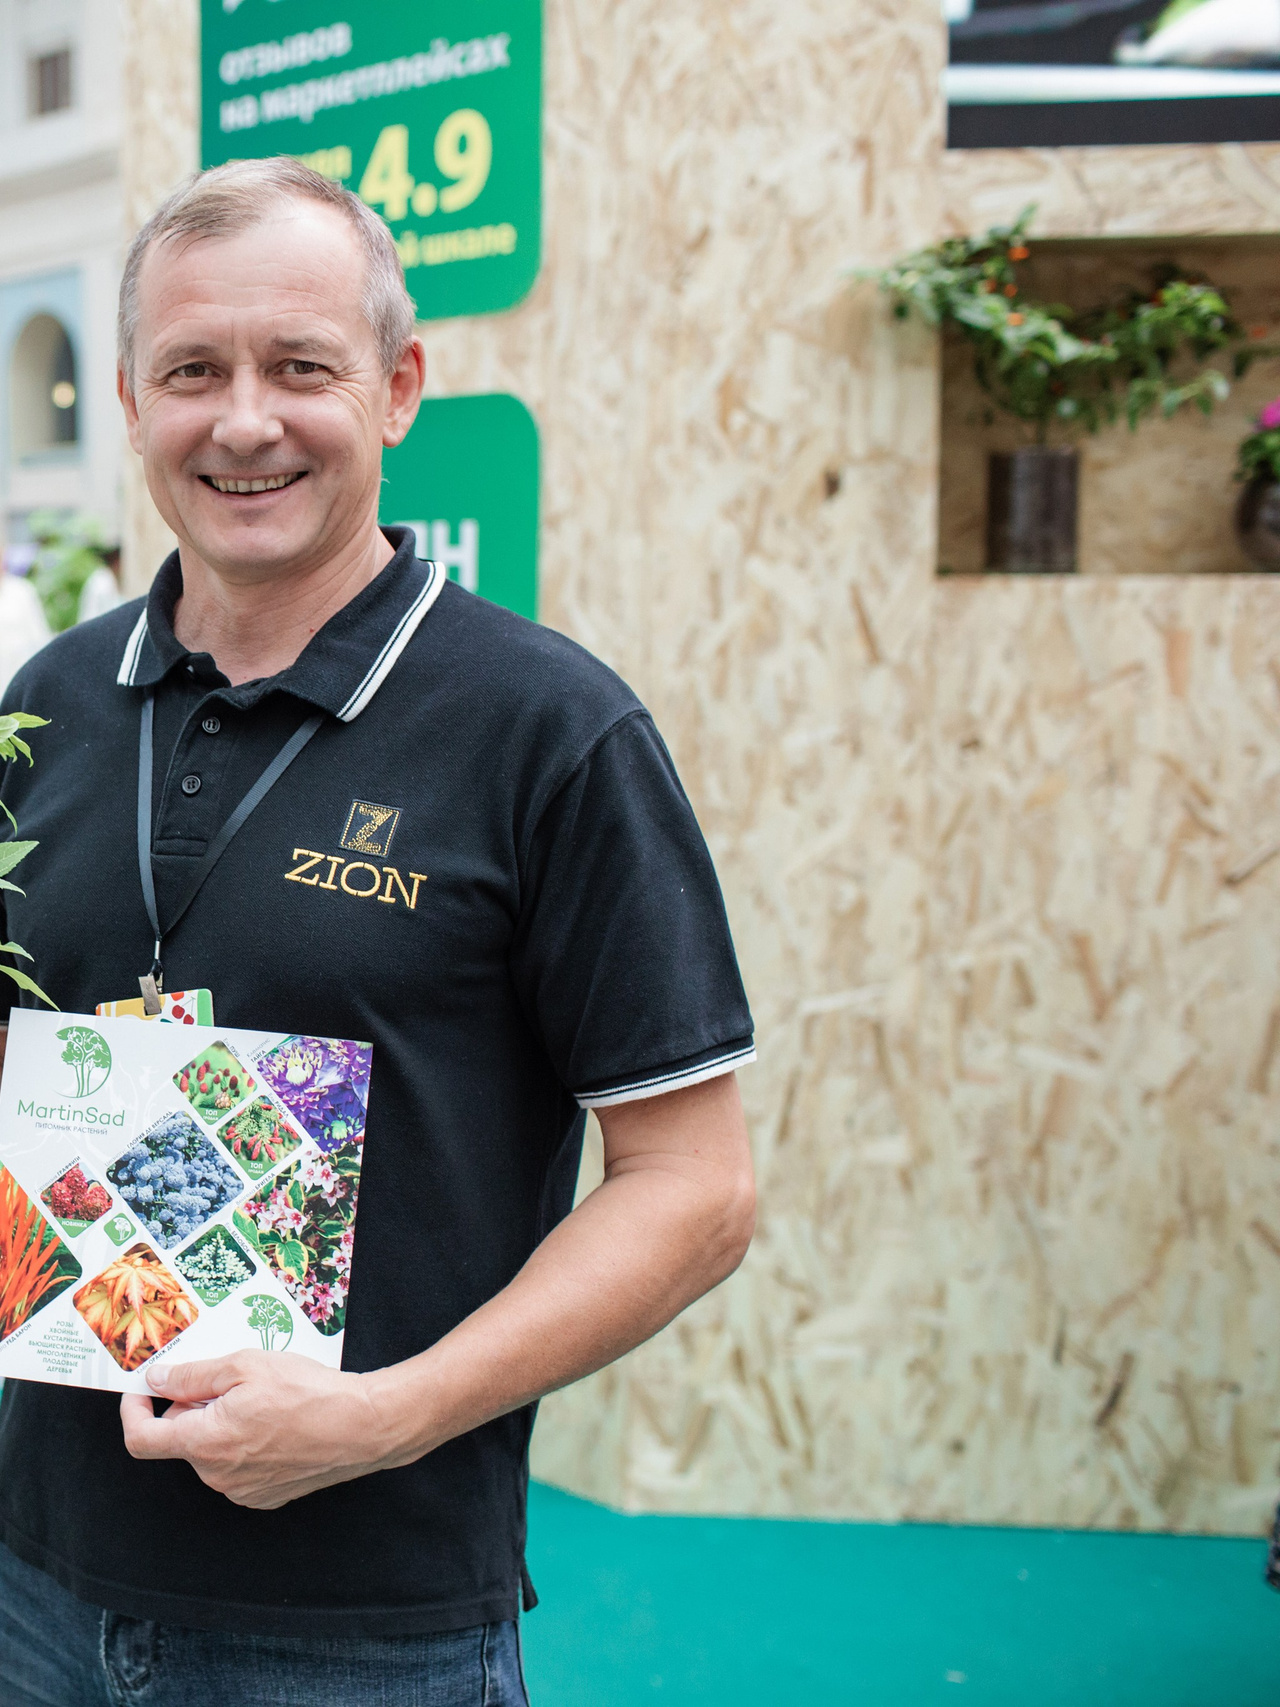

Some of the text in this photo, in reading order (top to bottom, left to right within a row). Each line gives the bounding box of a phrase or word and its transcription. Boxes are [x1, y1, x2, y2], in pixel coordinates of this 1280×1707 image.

[219, 22, 352, 84] отзывов
[219, 32, 511, 132] на маркетплейсах
[358, 108, 493, 221] 4.9
[421, 222, 517, 266] шкале
[284, 848, 428, 910] ZION
[251, 1050, 266, 1063] ТАЙГА
[17, 1099, 125, 1126] MartinSad
[35, 1122, 108, 1135] ПИТОМНИК РАСТЕНИЙ
[127, 1132, 145, 1149] ГЛОРИЯ
[145, 1126, 152, 1135] ДЕ
[151, 1110, 173, 1128] ВЕРСАЛЬ
[56, 1156, 81, 1176] ГРАФФИТИ
[61, 1220, 88, 1228] НОВИНКА
[56, 1320, 74, 1328] РОЗЫ
[6, 1336, 17, 1346] РЕД
[15, 1323, 32, 1338] БАРОН
[49, 1327, 79, 1336] ХВОЙНЫЕ
[43, 1335, 83, 1344] КУСТАРНИКИ
[28, 1340, 97, 1354] ВЬЮЩИЕСЯ РАСТЕНИЯ
[36, 1349, 87, 1361] МНОГОЛЕТНИКИ
[42, 1357, 79, 1367] ПЛОДОВЫЕ
[46, 1365, 73, 1374] ДЕРЕВЬЯ
